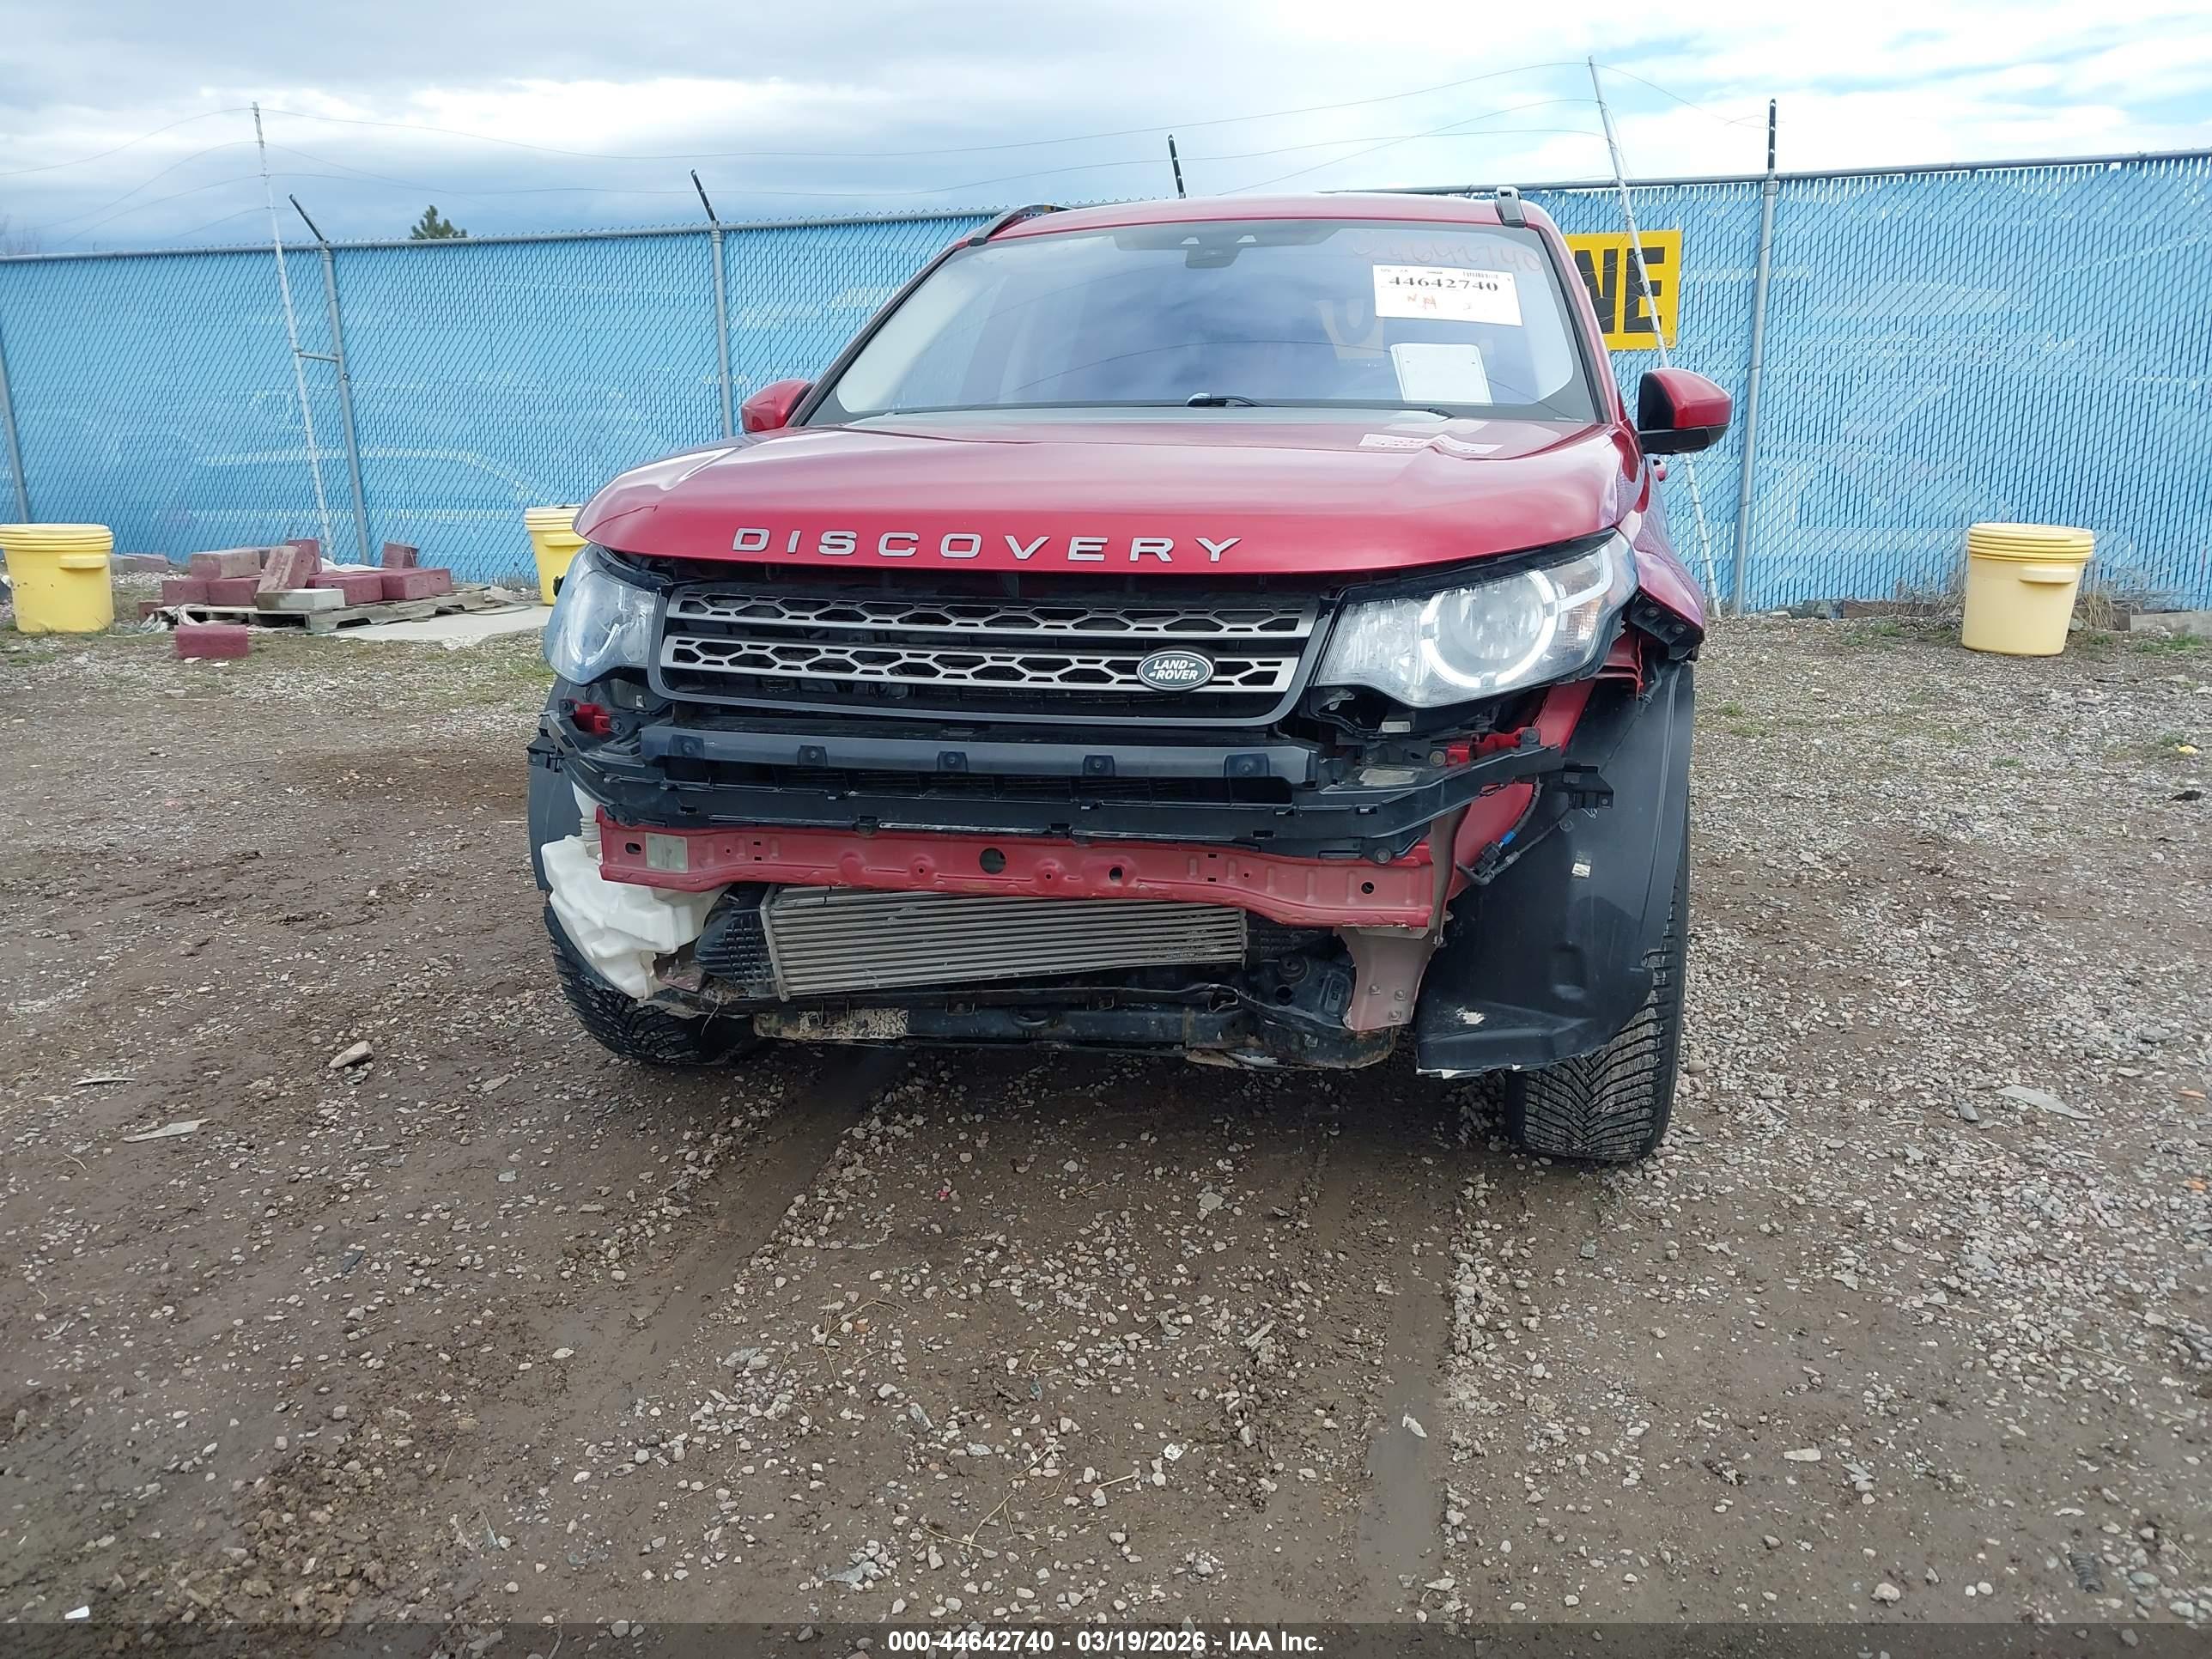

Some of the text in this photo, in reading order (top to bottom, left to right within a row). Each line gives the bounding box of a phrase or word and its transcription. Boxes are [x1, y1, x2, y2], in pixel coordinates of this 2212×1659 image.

[1389, 276, 1498, 292] 44642740
[732, 527, 1242, 562] DISCOVERY
[1153, 659, 1188, 670] LAND
[1155, 670, 1199, 680] ROVER
